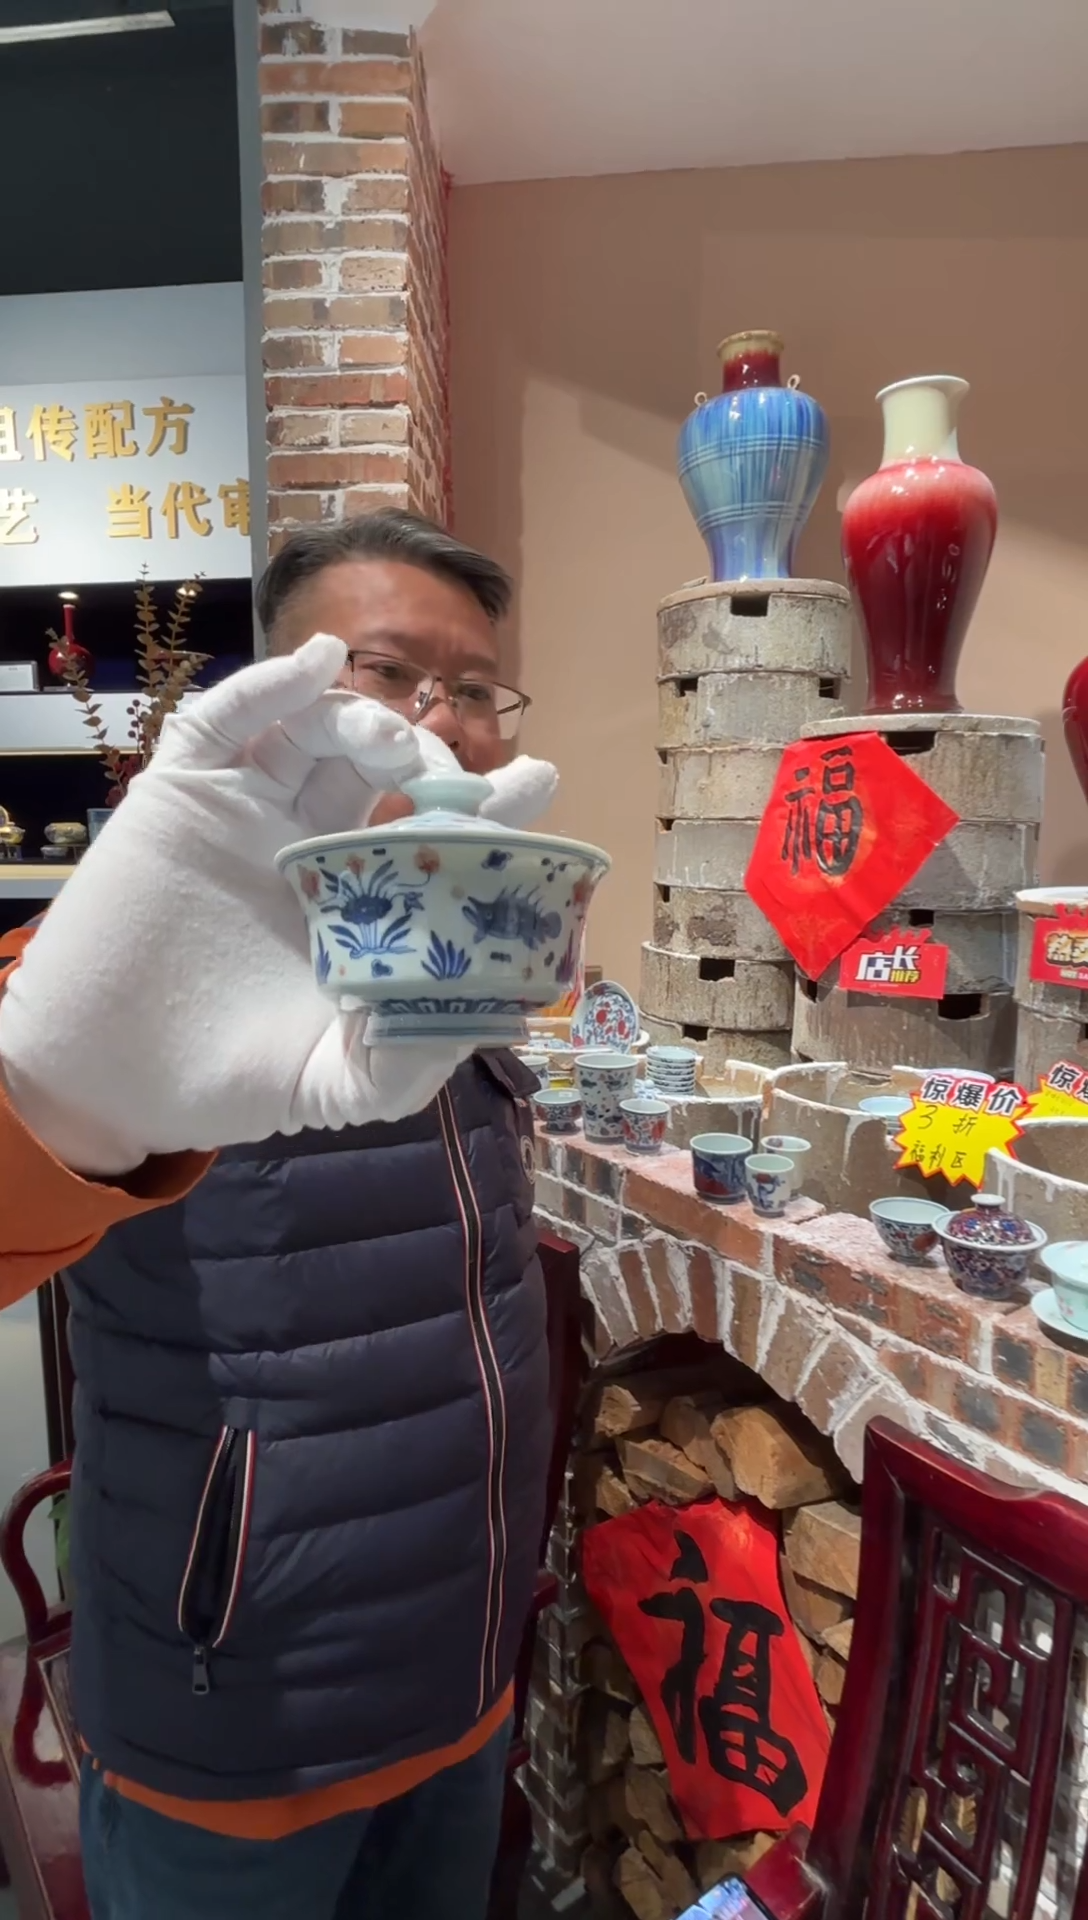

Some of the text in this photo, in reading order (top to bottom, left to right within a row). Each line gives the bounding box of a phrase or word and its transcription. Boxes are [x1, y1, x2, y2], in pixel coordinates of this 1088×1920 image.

[781, 746, 863, 876] 福
[855, 945, 920, 981] 店长
[922, 1077, 1020, 1114] 惊爆价
[910, 1141, 967, 1169] 福利区
[638, 1530, 808, 1817] 福
